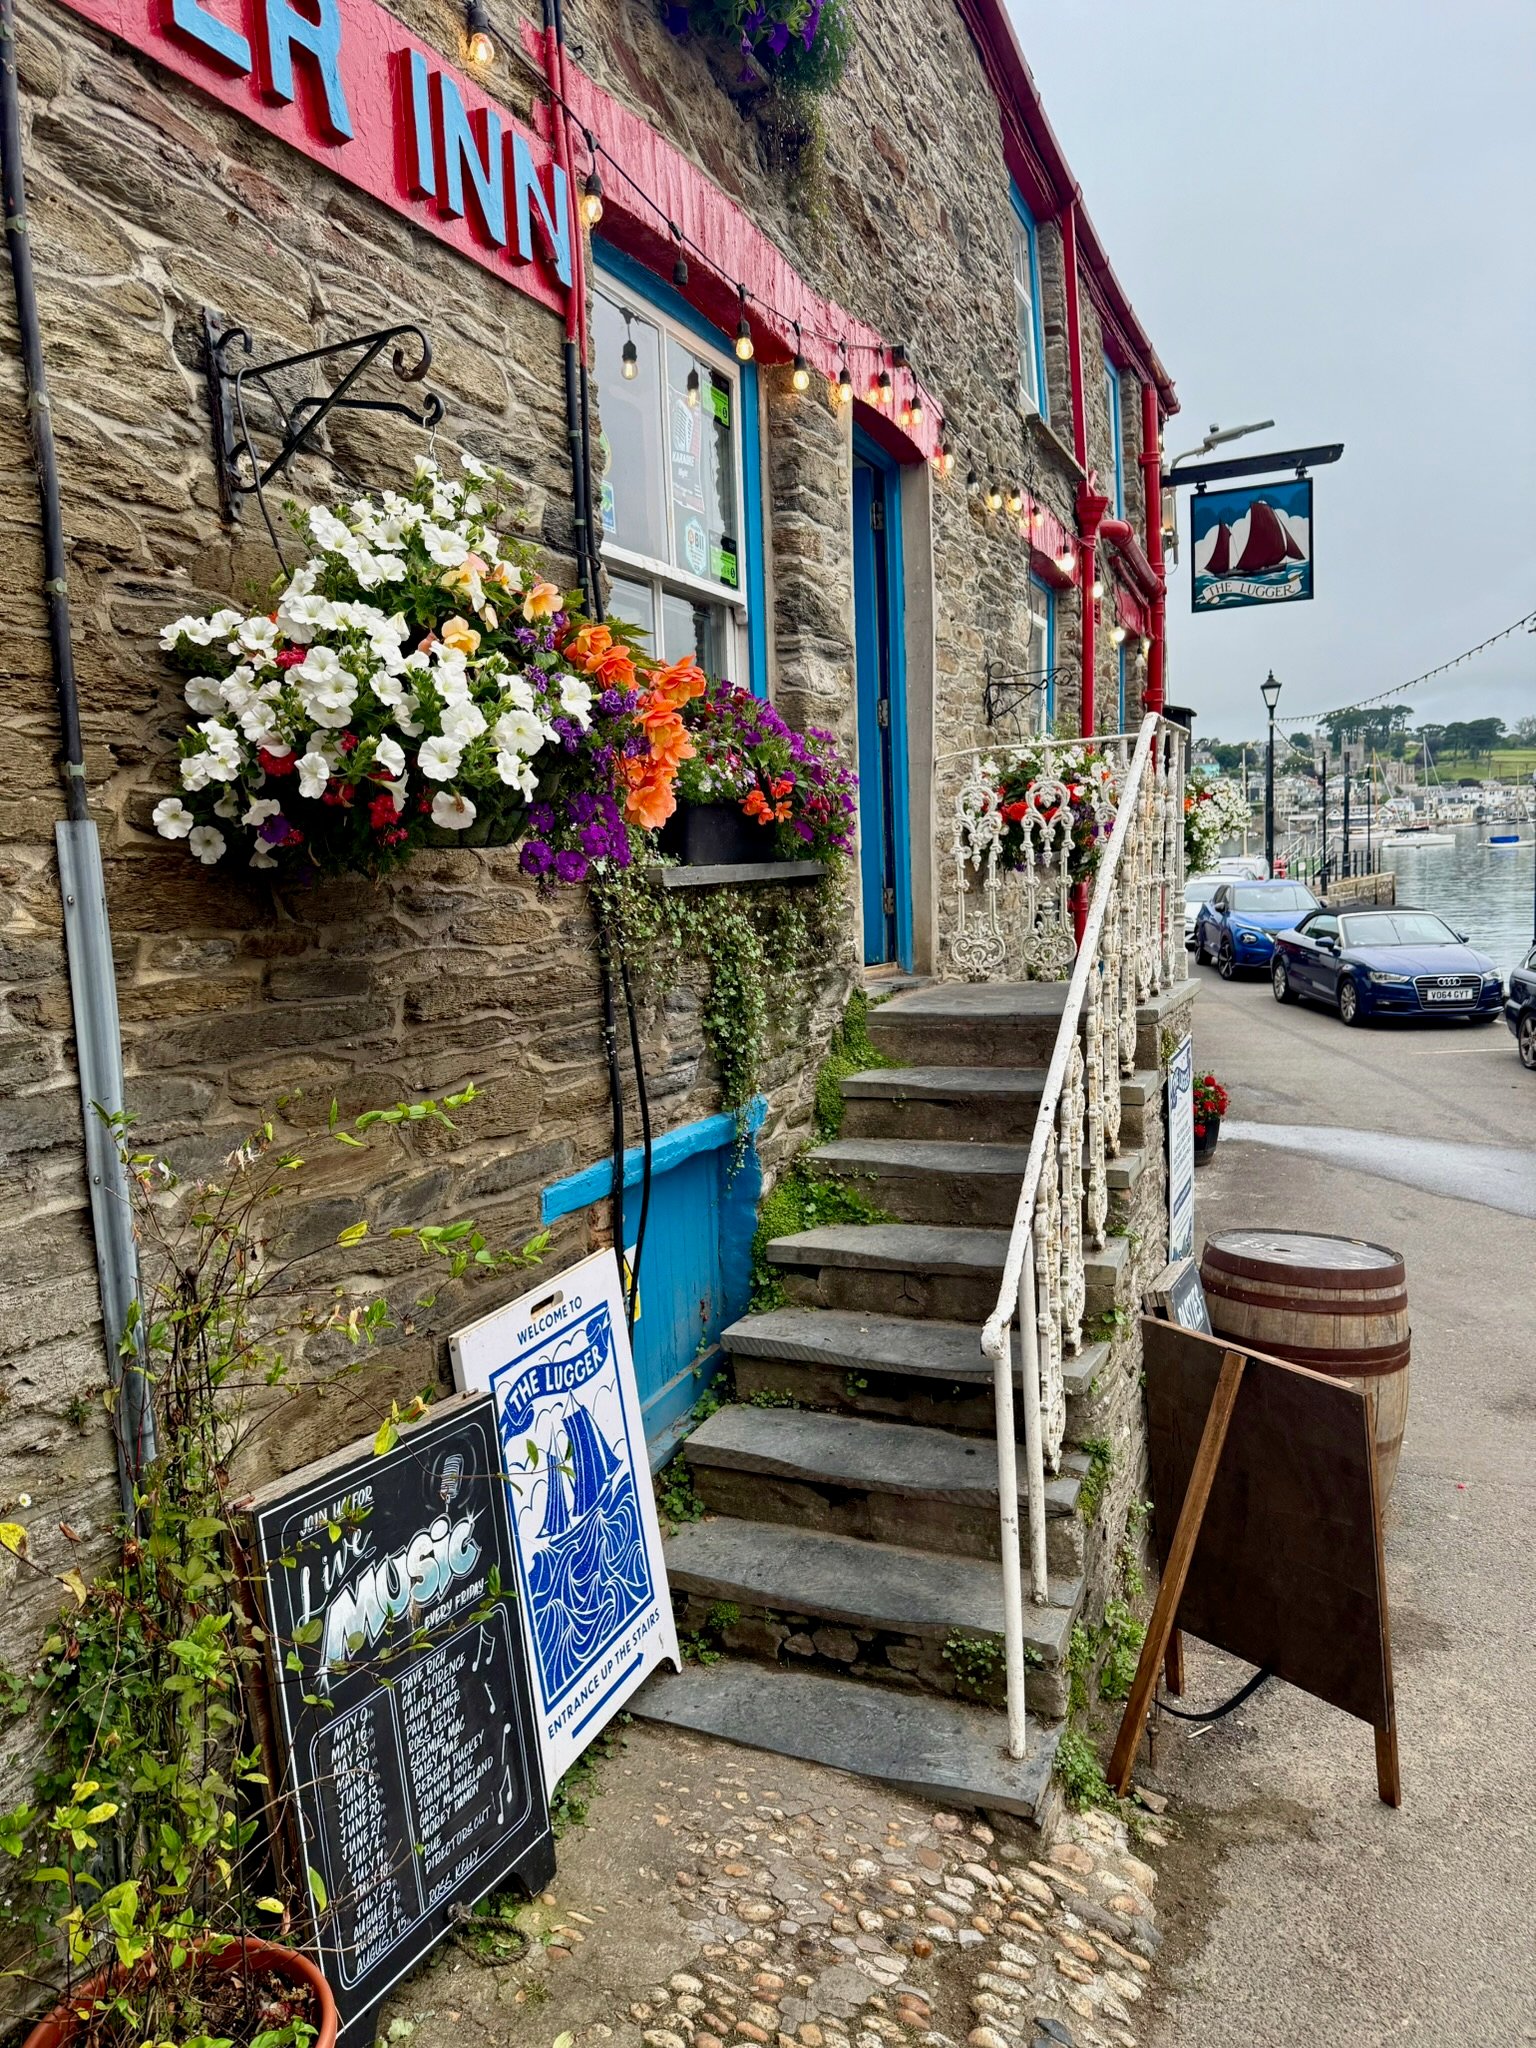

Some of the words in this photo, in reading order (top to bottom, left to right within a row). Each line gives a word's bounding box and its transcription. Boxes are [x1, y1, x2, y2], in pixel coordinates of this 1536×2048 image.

[407, 47, 572, 289] INN
[1207, 582, 1232, 597] THE
[1240, 584, 1295, 598] LUGGER
[1453, 990, 1470, 998] GYT
[516, 1304, 568, 1345] WELCOME
[569, 1296, 583, 1313] TO
[510, 1369, 540, 1412] THE
[545, 1344, 603, 1391] LUGGER
[299, 1508, 328, 1537] JOIN
[351, 1485, 374, 1512] FOR
[297, 1528, 373, 1627] Live
[424, 1601, 453, 1629] EVERY
[454, 1583, 485, 1609] FRIDAY
[401, 1665, 424, 1694] DAVE
[425, 1649, 447, 1675] RICH
[401, 1685, 419, 1711] CAT
[422, 1651, 466, 1695] FLORENCE
[547, 1674, 600, 1740] ENTRANCE
[601, 1660, 613, 1681] UP
[614, 1640, 632, 1664] THE
[632, 1608, 660, 1646] STAIRS
[404, 1693, 433, 1725] LAURA
[435, 1674, 457, 1701] KATE
[406, 1713, 429, 1741] PAUL
[431, 1689, 461, 1722] ARMER
[331, 1735, 353, 1764] MAY
[333, 1712, 358, 1744] MAY
[408, 1724, 431, 1754] ROSS
[433, 1703, 457, 1735] KELLY
[410, 1730, 446, 1770] SEAMUS
[448, 1714, 466, 1740] MAC
[333, 1752, 354, 1780] MAY
[411, 1751, 439, 1785] DAISY
[441, 1734, 460, 1761] MAE
[415, 1759, 451, 1800] REBECCA
[452, 1728, 485, 1768] PUCKEY
[338, 1775, 366, 1809] JUNE
[417, 1776, 451, 1812] JOANNA
[453, 1756, 475, 1783] COOK
[339, 1792, 368, 1828] JUNE
[340, 1809, 369, 1844] JUNE
[419, 1802, 441, 1828] GARY
[421, 1807, 451, 1842] MOREY
[454, 1780, 480, 1813] DAMON
[342, 1827, 369, 1861] JUNE
[347, 1840, 372, 1874] JULY
[424, 1832, 442, 1860] RUE
[425, 1824, 474, 1875] DIRECTORS
[351, 1857, 375, 1887] JULY
[353, 1869, 378, 1903] JULY
[428, 1873, 453, 1906] ROSS
[454, 1846, 480, 1880] KELLY
[353, 1895, 390, 1942] AUGUST
[356, 1888, 379, 1919] JULY
[355, 1912, 390, 1957] AUGUST
[356, 1924, 395, 1976] AUGUST
